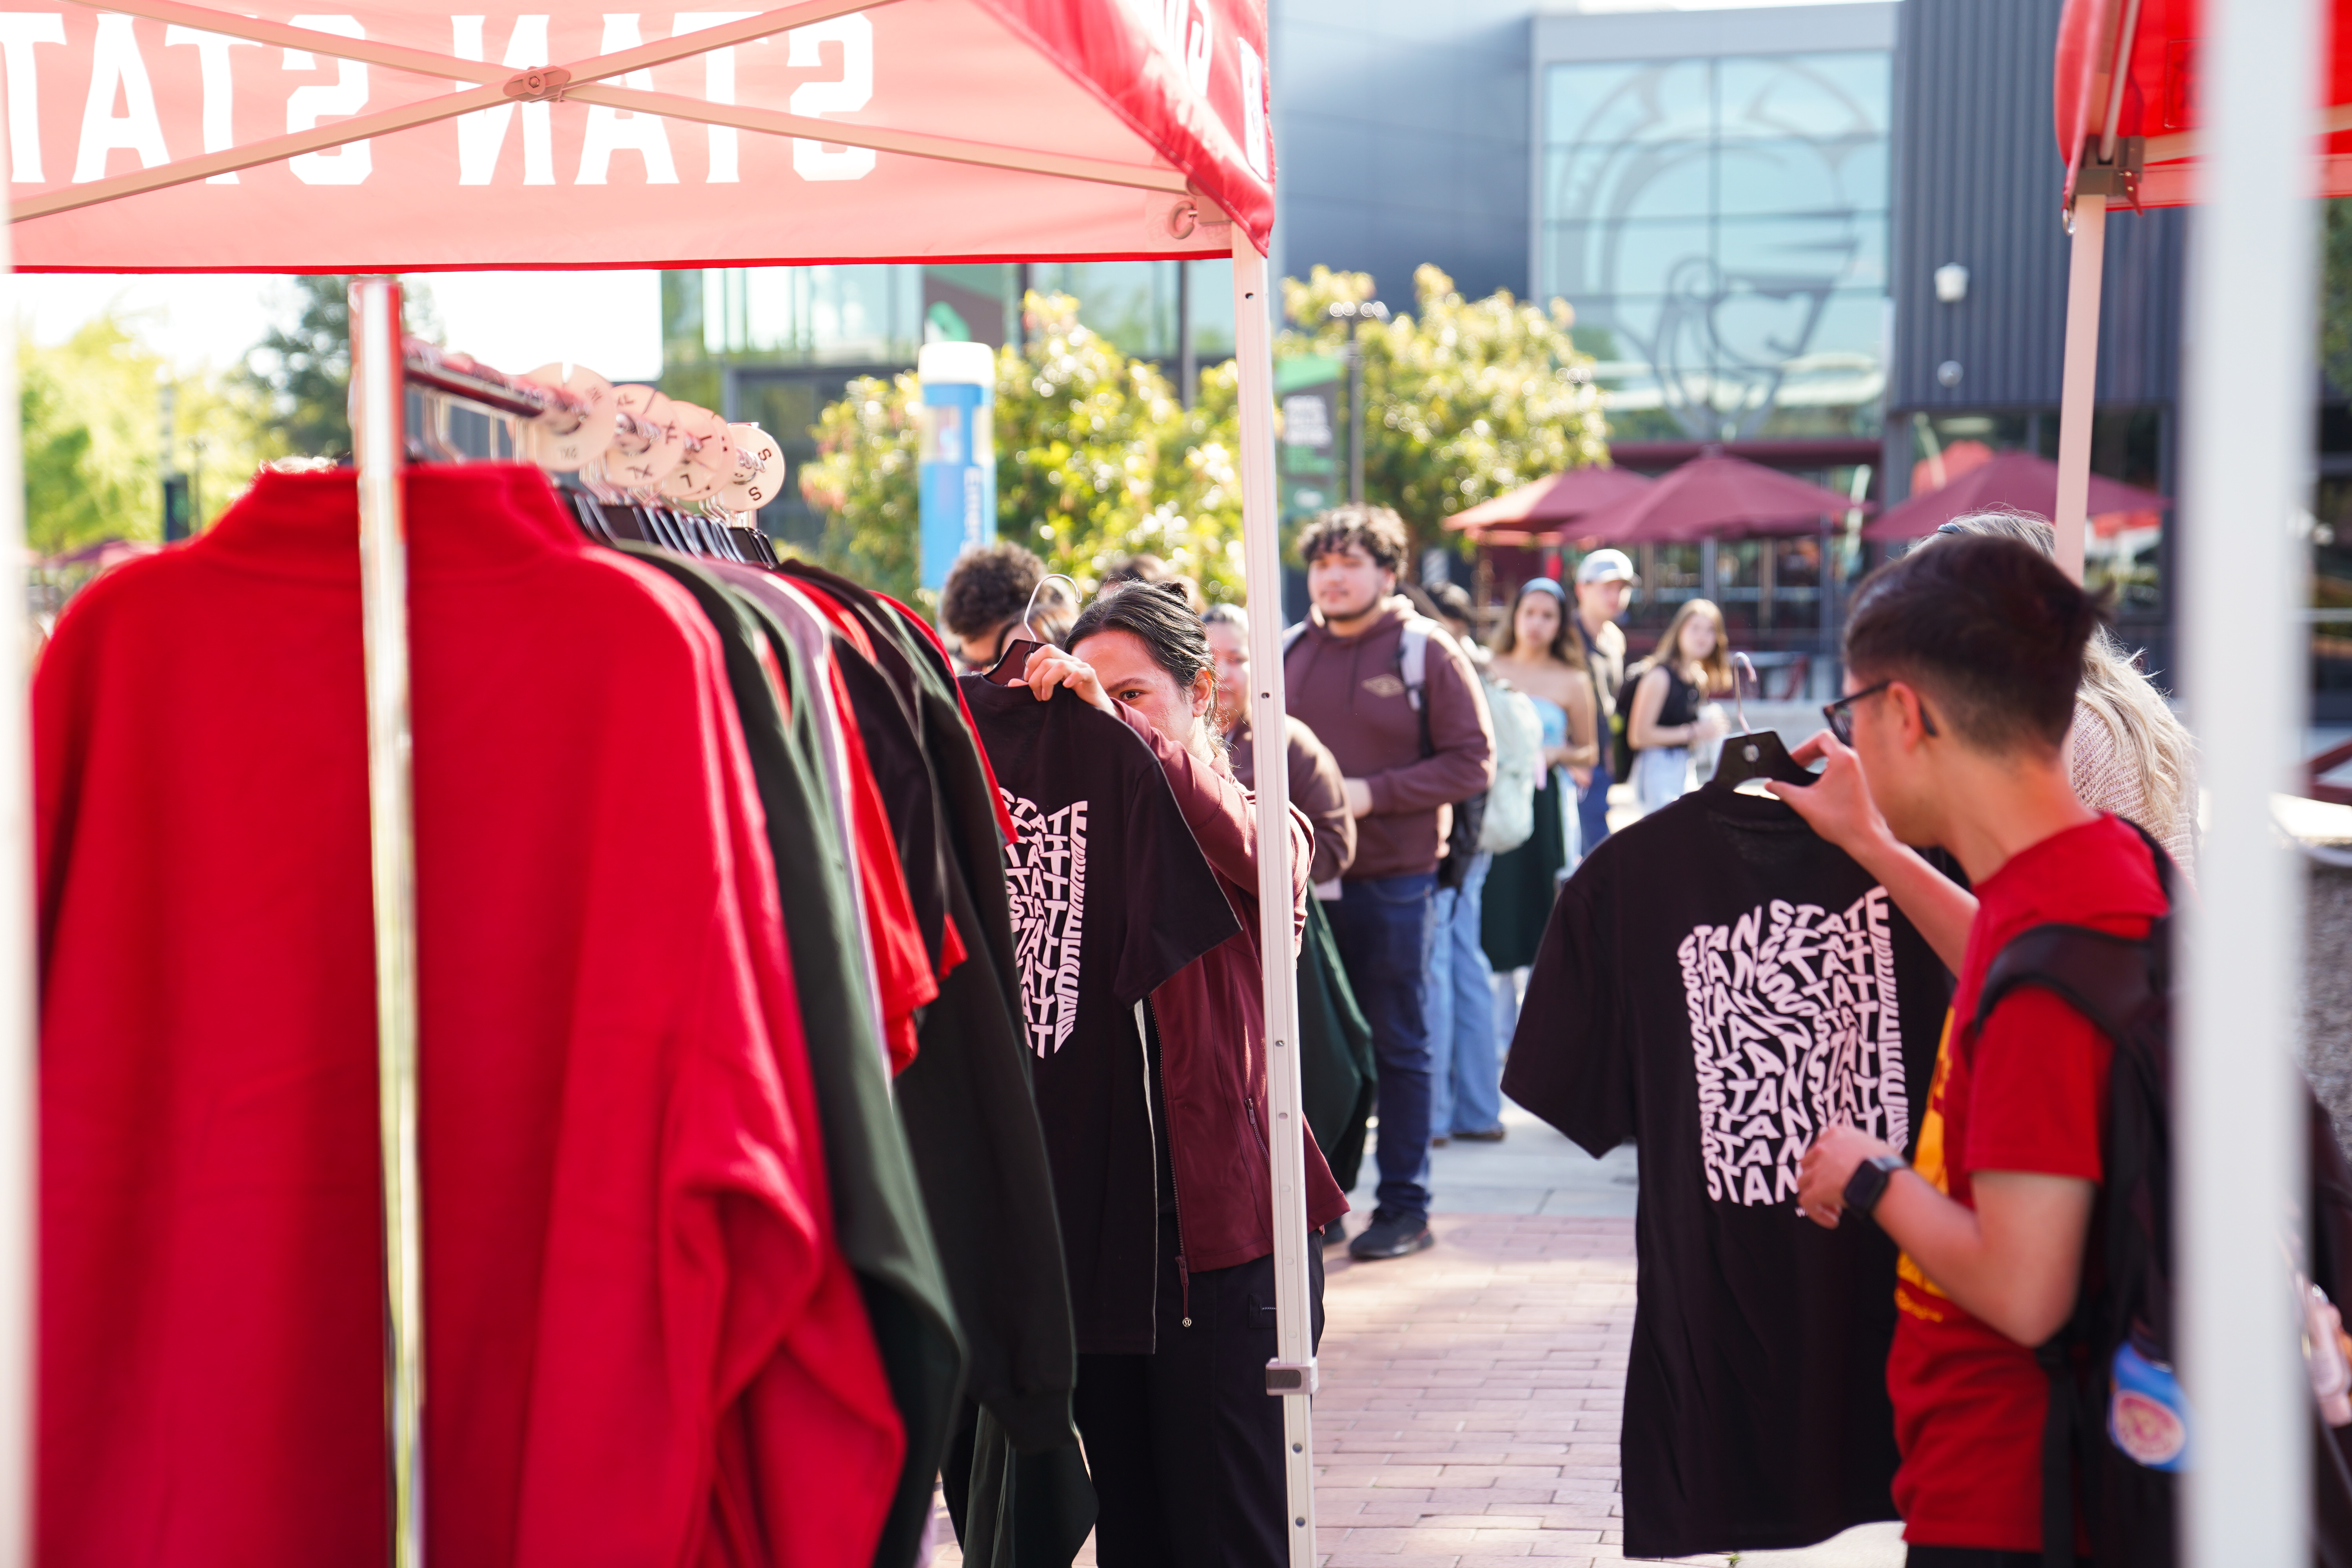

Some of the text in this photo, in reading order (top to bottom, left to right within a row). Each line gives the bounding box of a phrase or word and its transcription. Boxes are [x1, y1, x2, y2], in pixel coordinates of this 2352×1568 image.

[758, 448, 772, 461] S
[748, 486, 762, 501] S
[1004, 867, 1085, 911] TATE
[1009, 894, 1084, 939] STATE
[1677, 884, 1891, 968] STAN STATE
[1010, 917, 1081, 970] TATE
[1682, 926, 1893, 991] STAN STATE
[1016, 953, 1079, 999] ATE
[1686, 946, 1896, 1025] STAN STATE
[1021, 986, 1078, 1025] ATE
[1690, 973, 1899, 1059] STAN STATE
[1695, 999, 1902, 1085] STAN STATE
[1698, 1050, 1811, 1114] STAN
[1807, 1025, 1906, 1094] STATE
[1700, 1099, 1814, 1140] STAN
[1811, 1067, 1909, 1128] STATE
[1701, 1127, 1814, 1167] STAN
[1704, 1154, 1804, 1207] STAN
